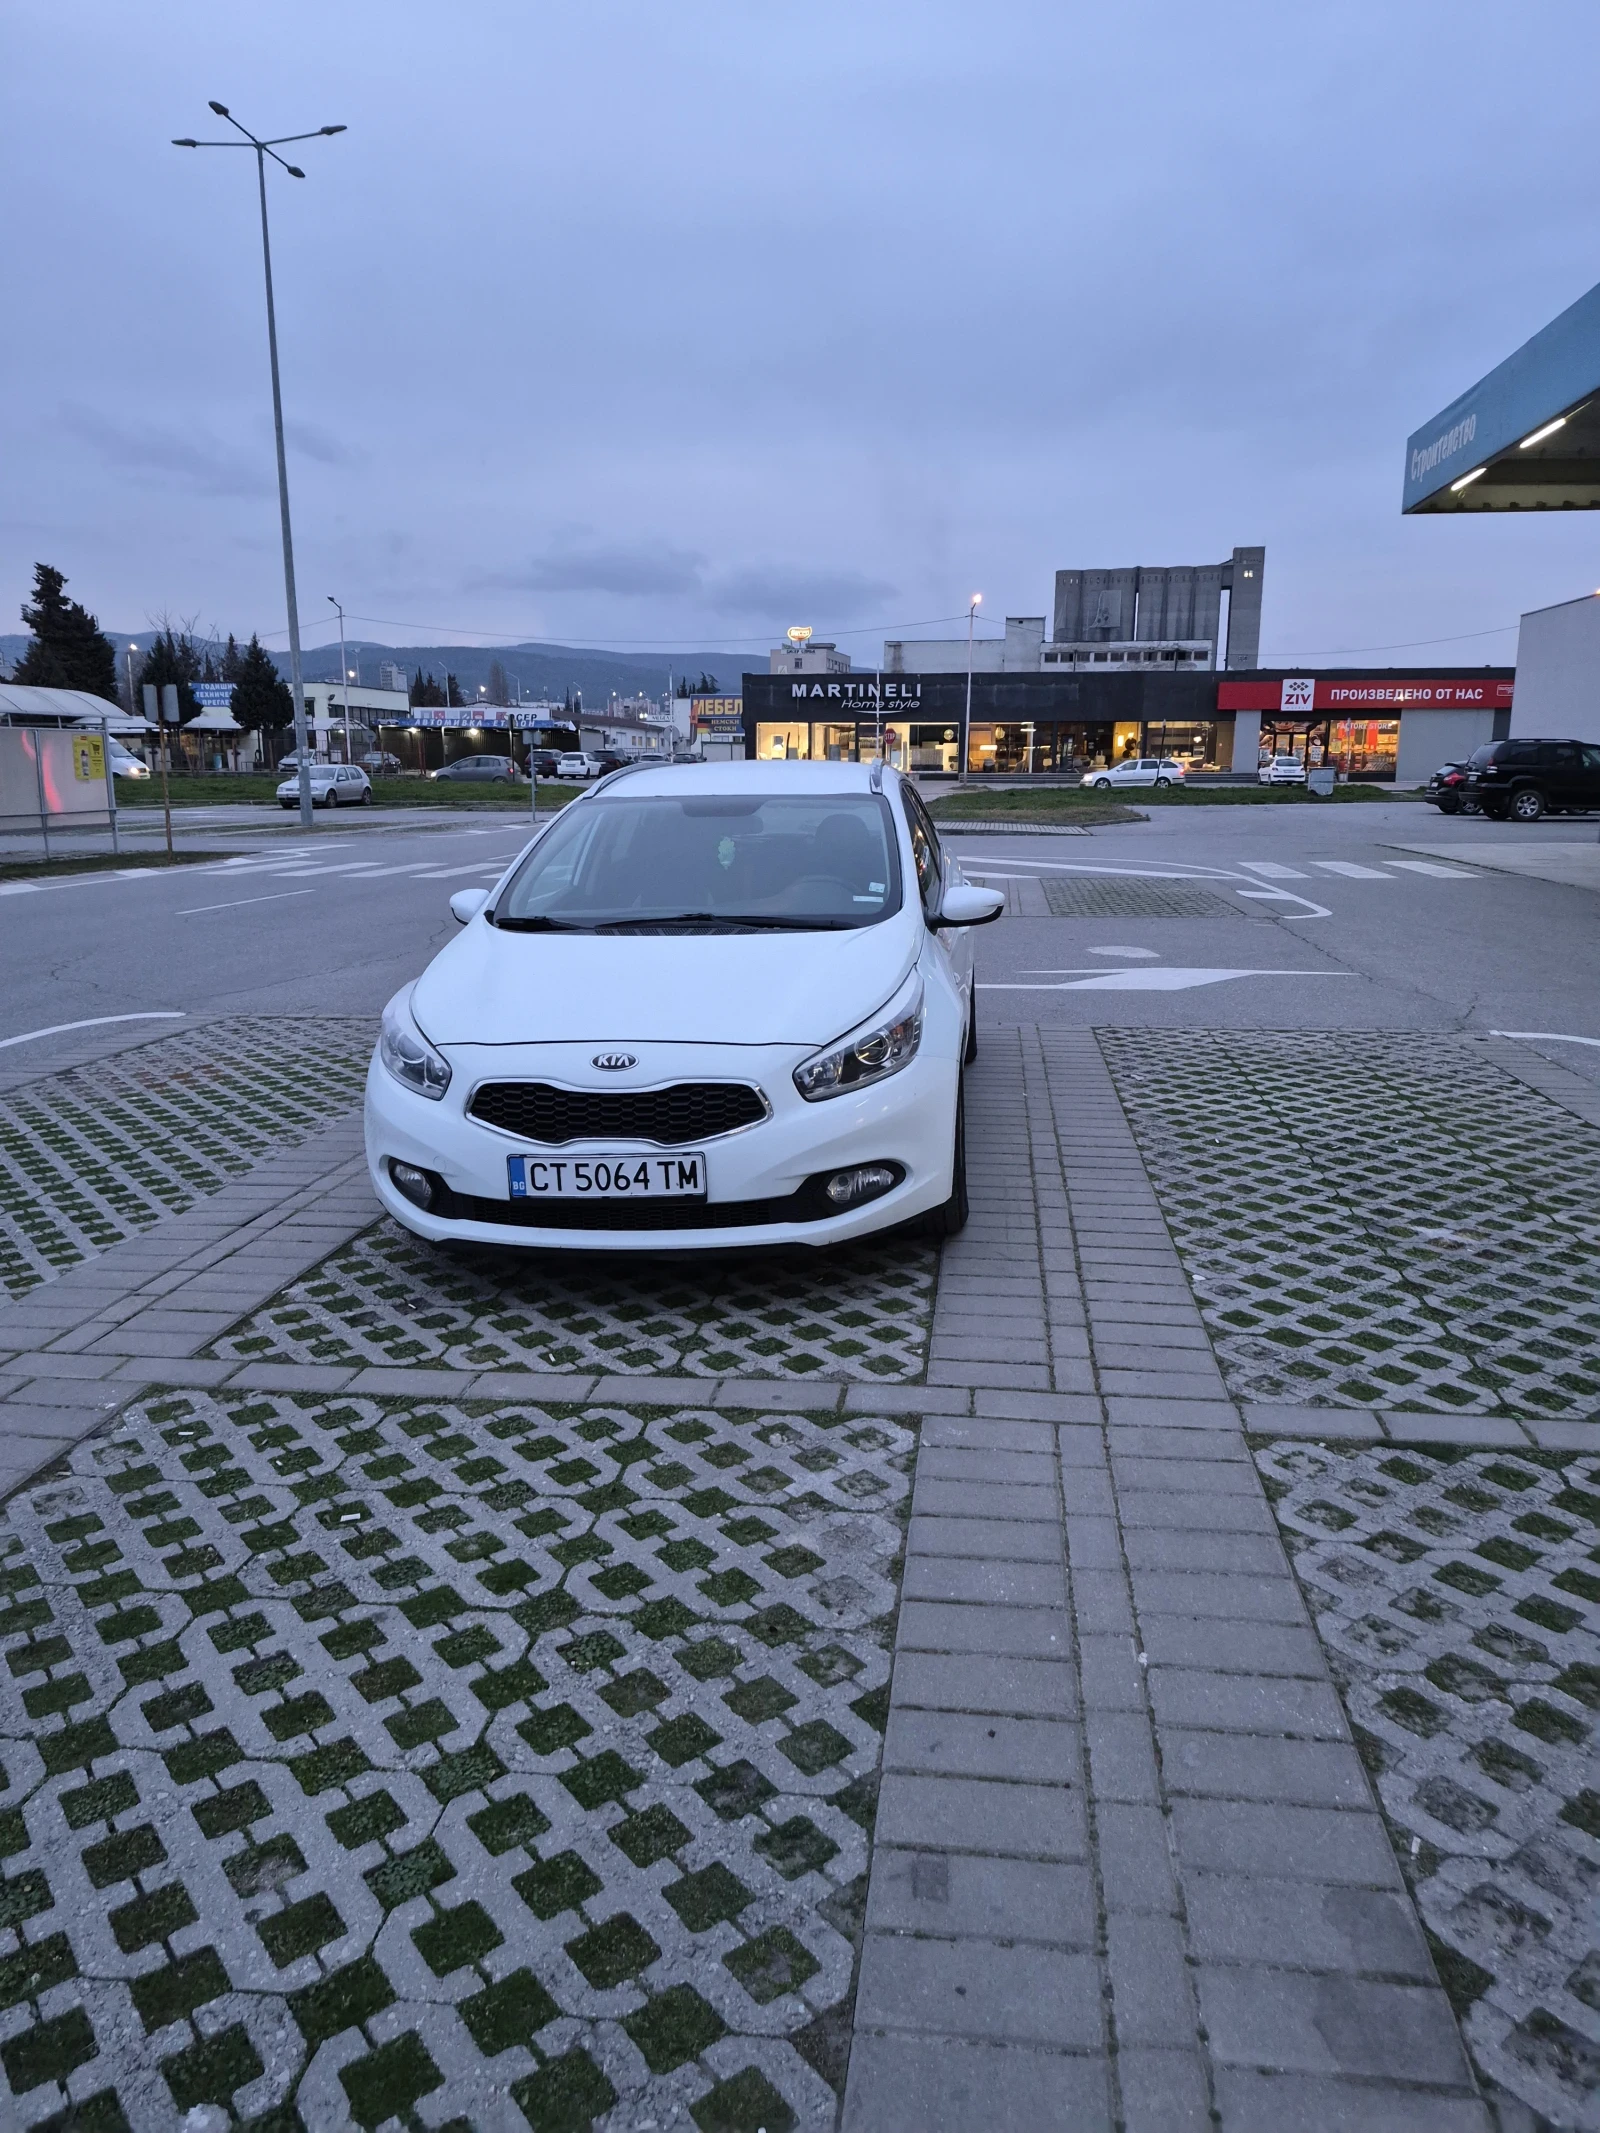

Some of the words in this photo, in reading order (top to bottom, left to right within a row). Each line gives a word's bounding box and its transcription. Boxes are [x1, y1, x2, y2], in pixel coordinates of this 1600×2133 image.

[1411, 414, 1476, 482] Строителство
[792, 683, 921, 697] MARTINELI
[1331, 688, 1431, 701] ПРОИЗВЕДЕНО
[1435, 688, 1453, 700] ОТ
[1455, 688, 1483, 700] НАС
[841, 699, 884, 708] Home
[888, 699, 920, 709] style
[1284, 693, 1311, 704] ZIV
[414, 719, 482, 727] АВТОМИВКА
[1369, 722, 1392, 730] STORE
[597, 1054, 630, 1066] KIA
[512, 1181, 525, 1190] BG
